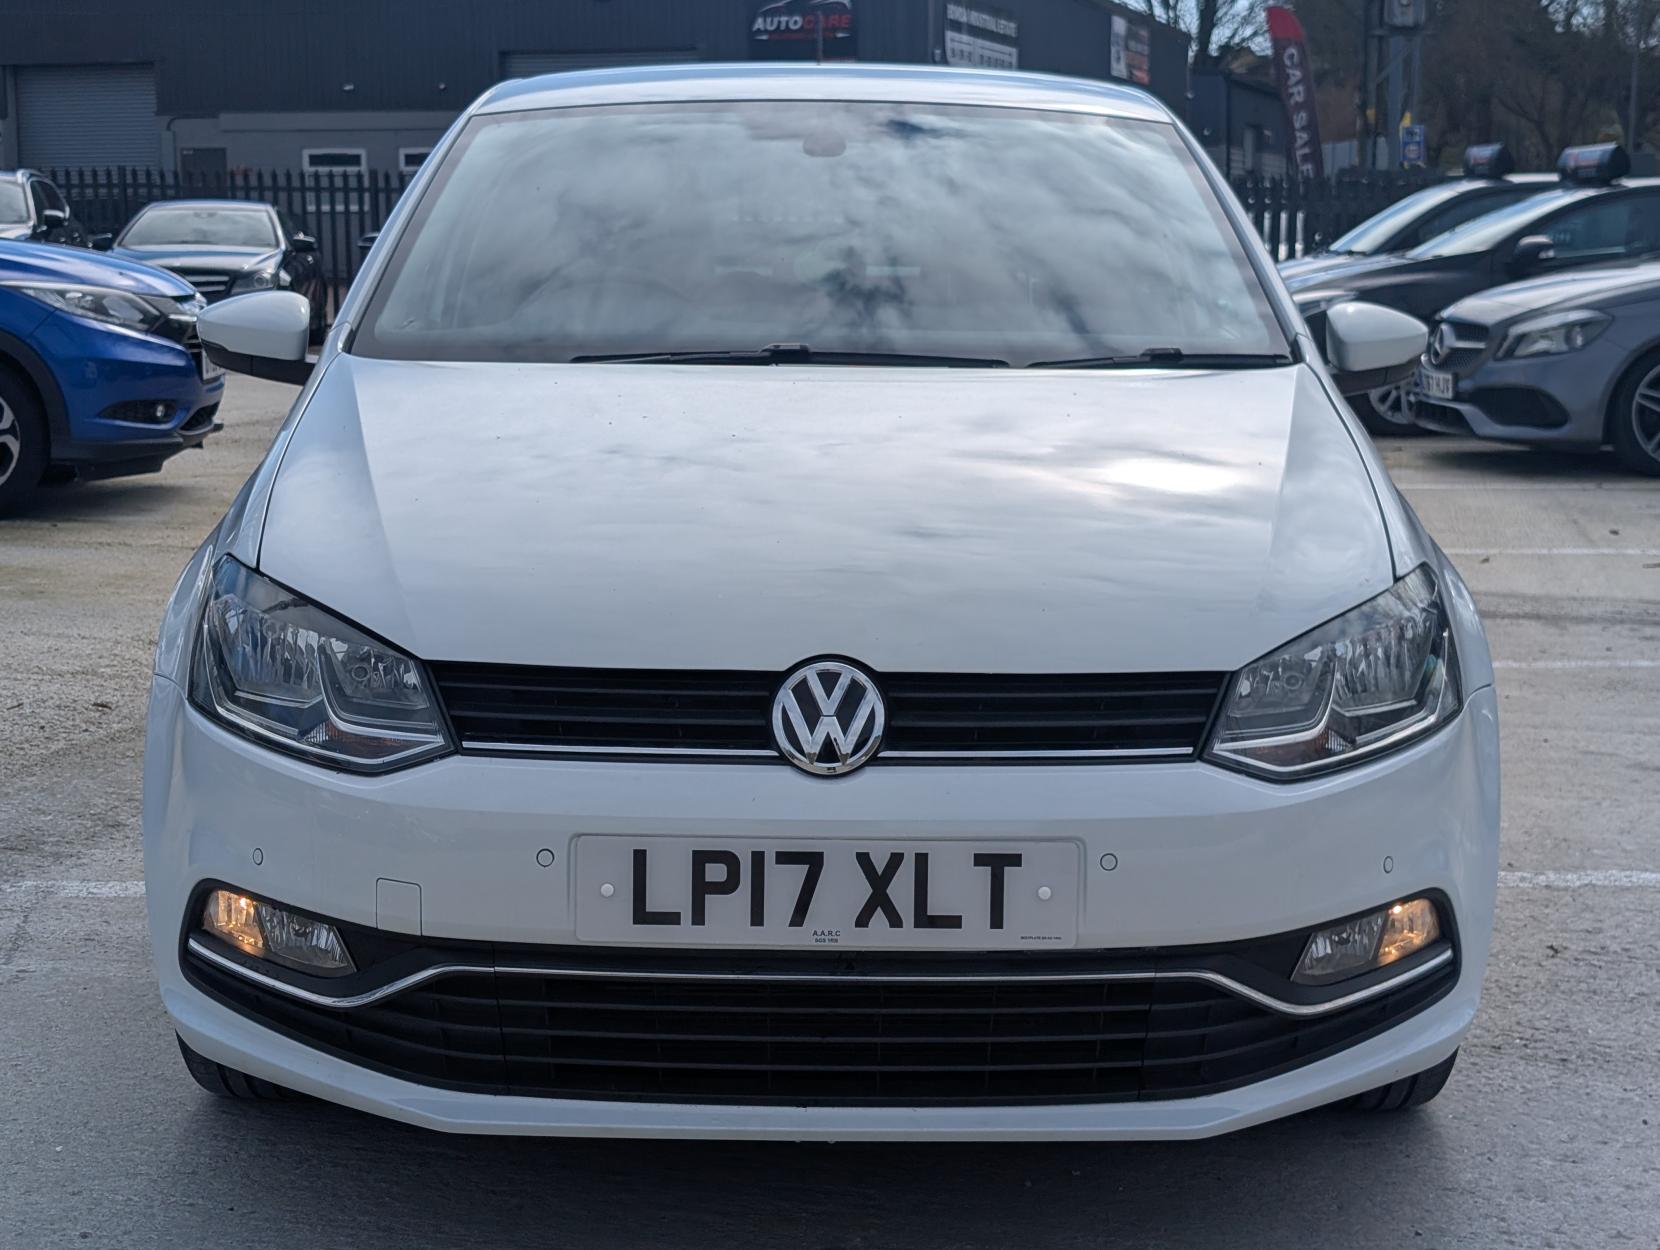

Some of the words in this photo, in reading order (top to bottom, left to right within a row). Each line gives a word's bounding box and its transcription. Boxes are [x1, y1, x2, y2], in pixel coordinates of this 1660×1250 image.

[1283, 47, 1304, 104] CAR
[632, 848, 824, 927] LP17
[854, 851, 1022, 929] XLT
